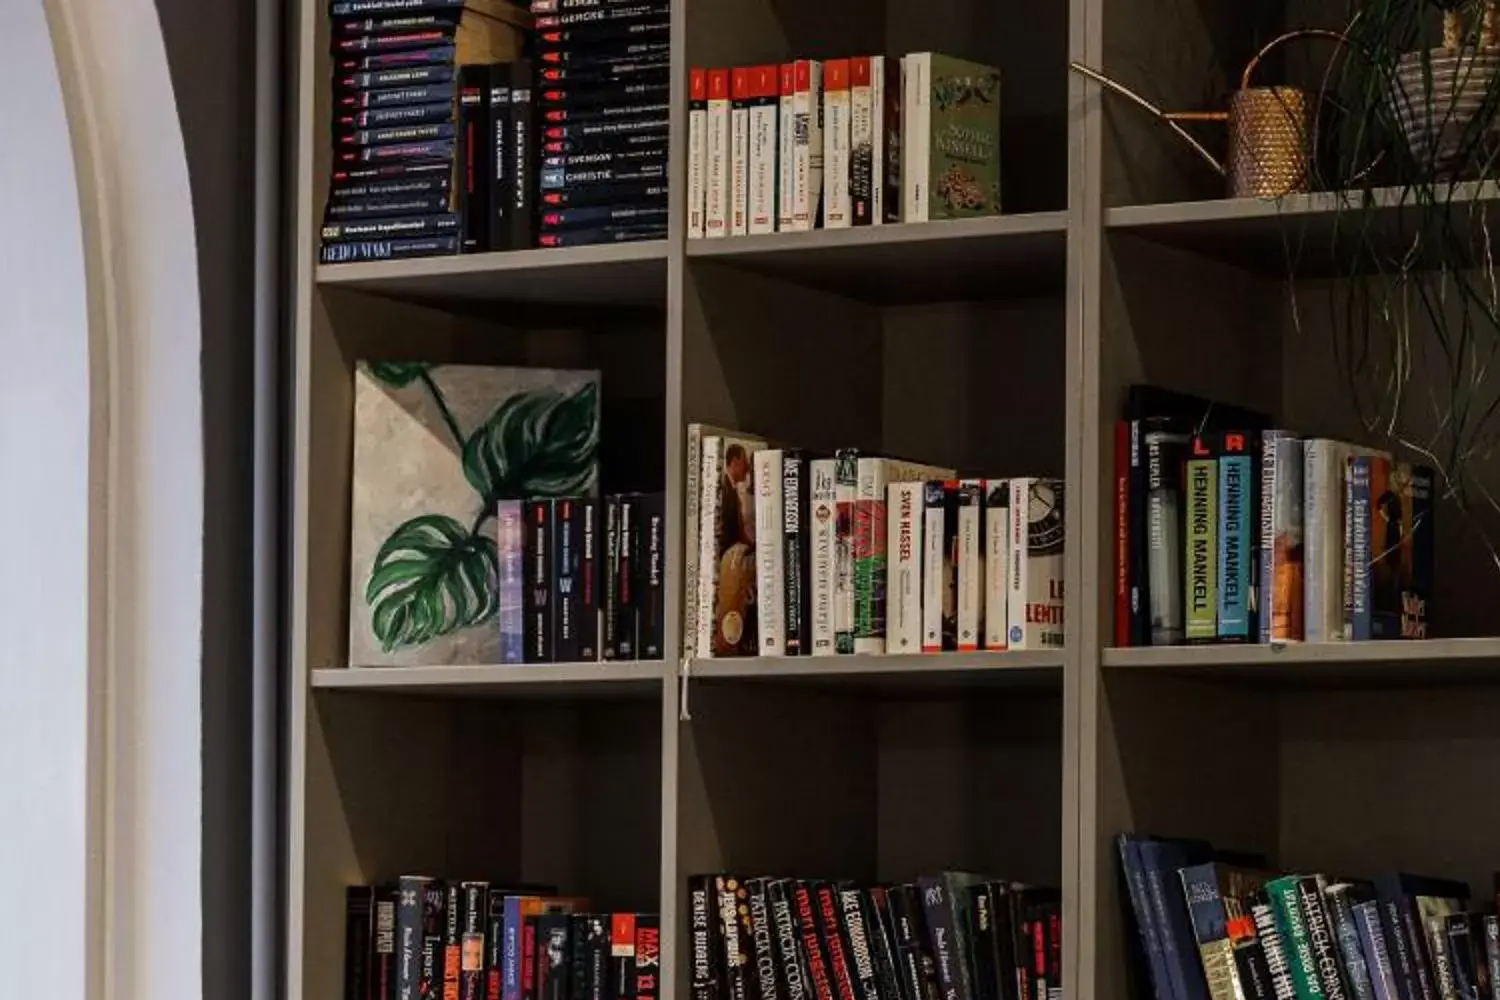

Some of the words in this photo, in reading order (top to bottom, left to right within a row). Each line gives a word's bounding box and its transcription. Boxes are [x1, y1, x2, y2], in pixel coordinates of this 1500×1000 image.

[1192, 466, 1208, 534] HENNING
[1226, 463, 1241, 532] HENNING
[1193, 539, 1208, 613] MANKELL
[1225, 536, 1240, 610] MANKELL
[692, 890, 706, 929] DENISE
[751, 894, 767, 954] PATRICIA
[775, 901, 797, 962] PATRICIA
[1250, 904, 1292, 972] ANTONIO
[1303, 892, 1329, 955] PATRICIA
[692, 930, 708, 979] RUDBERG
